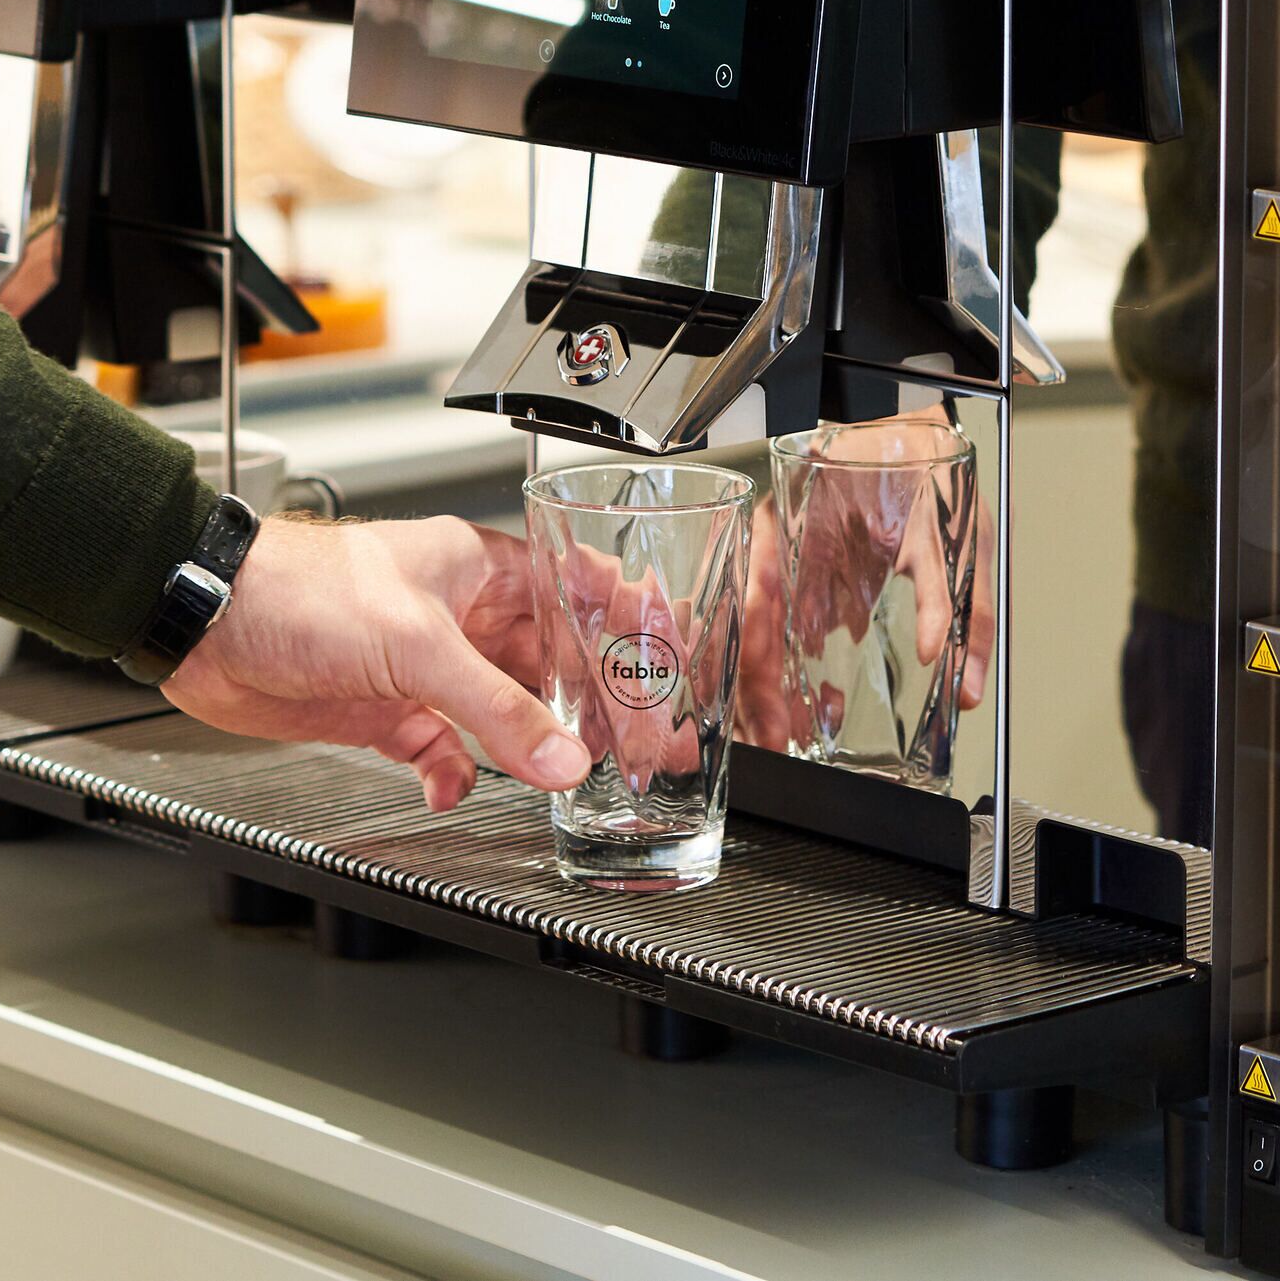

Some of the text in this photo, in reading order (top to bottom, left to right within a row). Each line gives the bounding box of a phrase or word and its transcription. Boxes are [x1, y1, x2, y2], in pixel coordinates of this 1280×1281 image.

[591, 11, 632, 25] Hot Chocolate
[659, 20, 670, 30] Tea
[614, 640, 642, 657] ORIGINAL
[611, 660, 669, 680] fabia
